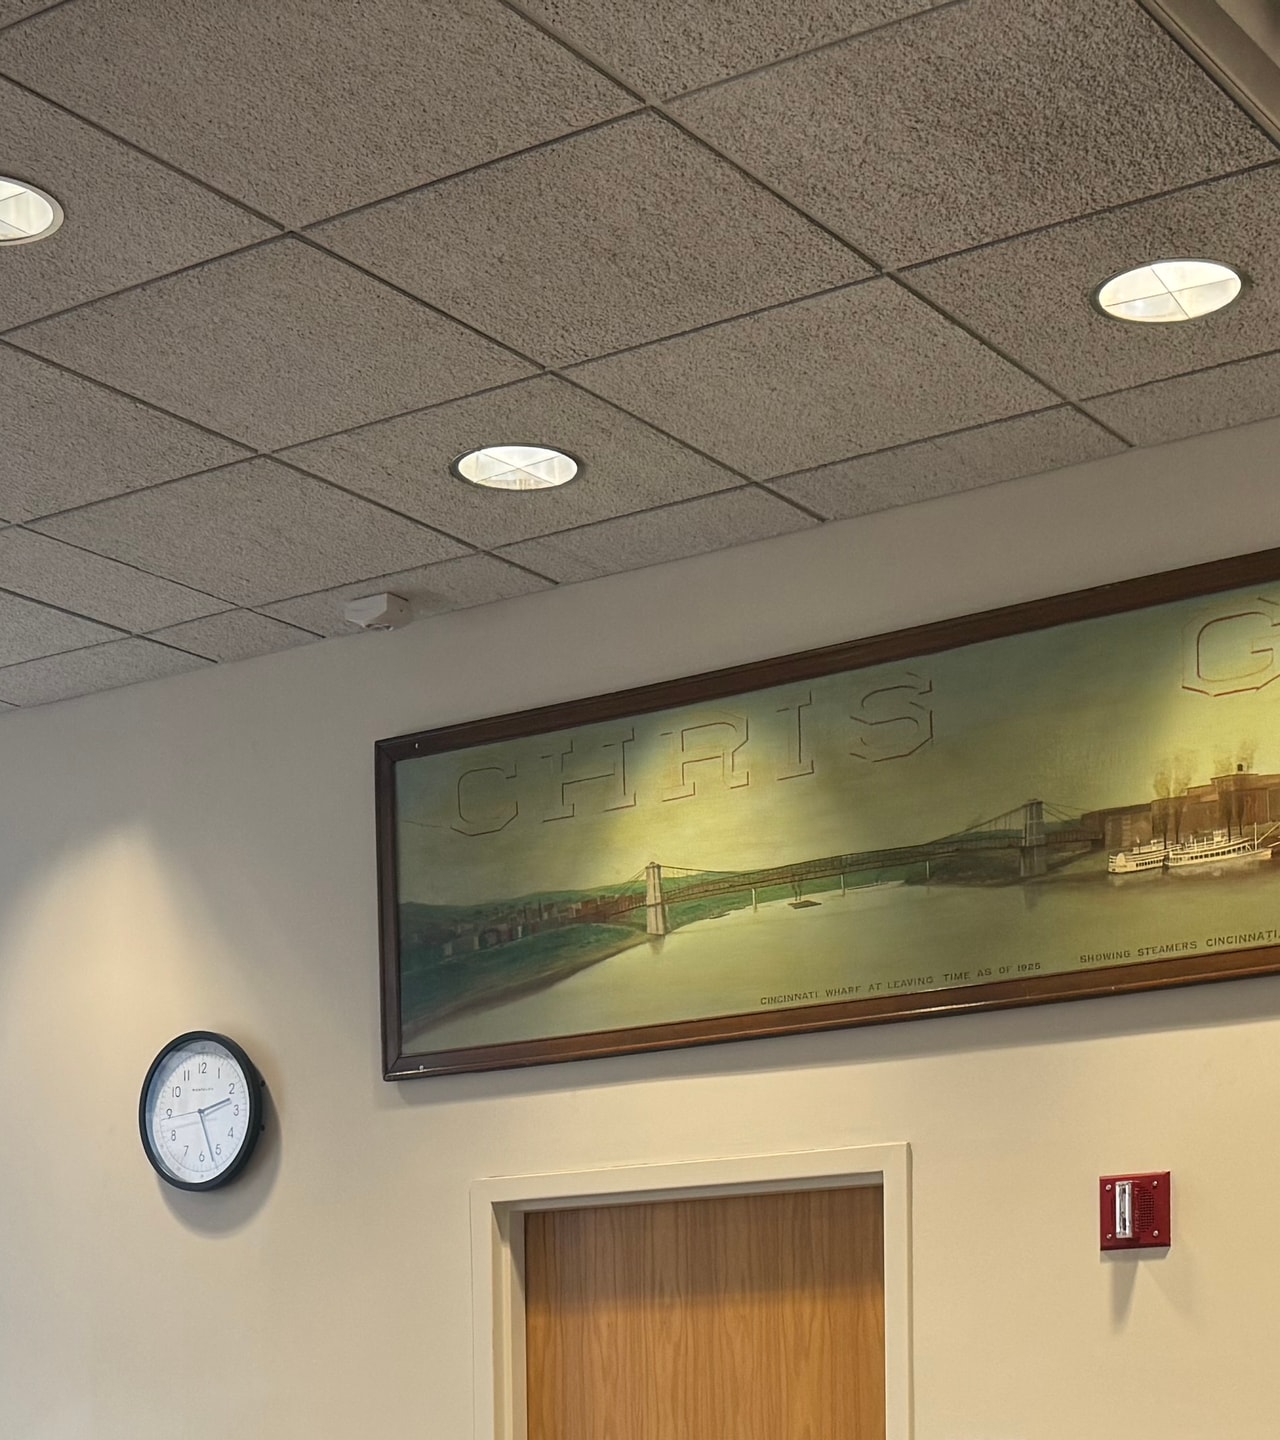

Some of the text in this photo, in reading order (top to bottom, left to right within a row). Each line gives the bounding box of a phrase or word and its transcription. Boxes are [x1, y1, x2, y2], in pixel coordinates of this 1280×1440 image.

[451, 673, 935, 837] CHRIS
[760, 991, 819, 1006] CINCINNATI
[825, 985, 862, 998] WHARF
[868, 982, 882, 993] AT
[887, 976, 934, 990] LEAVING
[943, 971, 970, 982] TIME
[977, 968, 992, 977] AS
[999, 965, 1013, 974] OF
[1079, 950, 1131, 964] SHOWING
[1137, 941, 1198, 957] STEAMERS
[198, 1062, 207, 1074] 12
[183, 1069, 190, 1082] 11
[172, 1086, 181, 1098] 10
[228, 1083, 235, 1095] 2
[166, 1108, 173, 1120] 9
[233, 1104, 240, 1116] 3
[171, 1129, 177, 1142] 8
[227, 1126, 234, 1138] 4
[183, 1145, 190, 1157] 7
[215, 1143, 222, 1156] 5
[198, 1150, 205, 1162] 6
